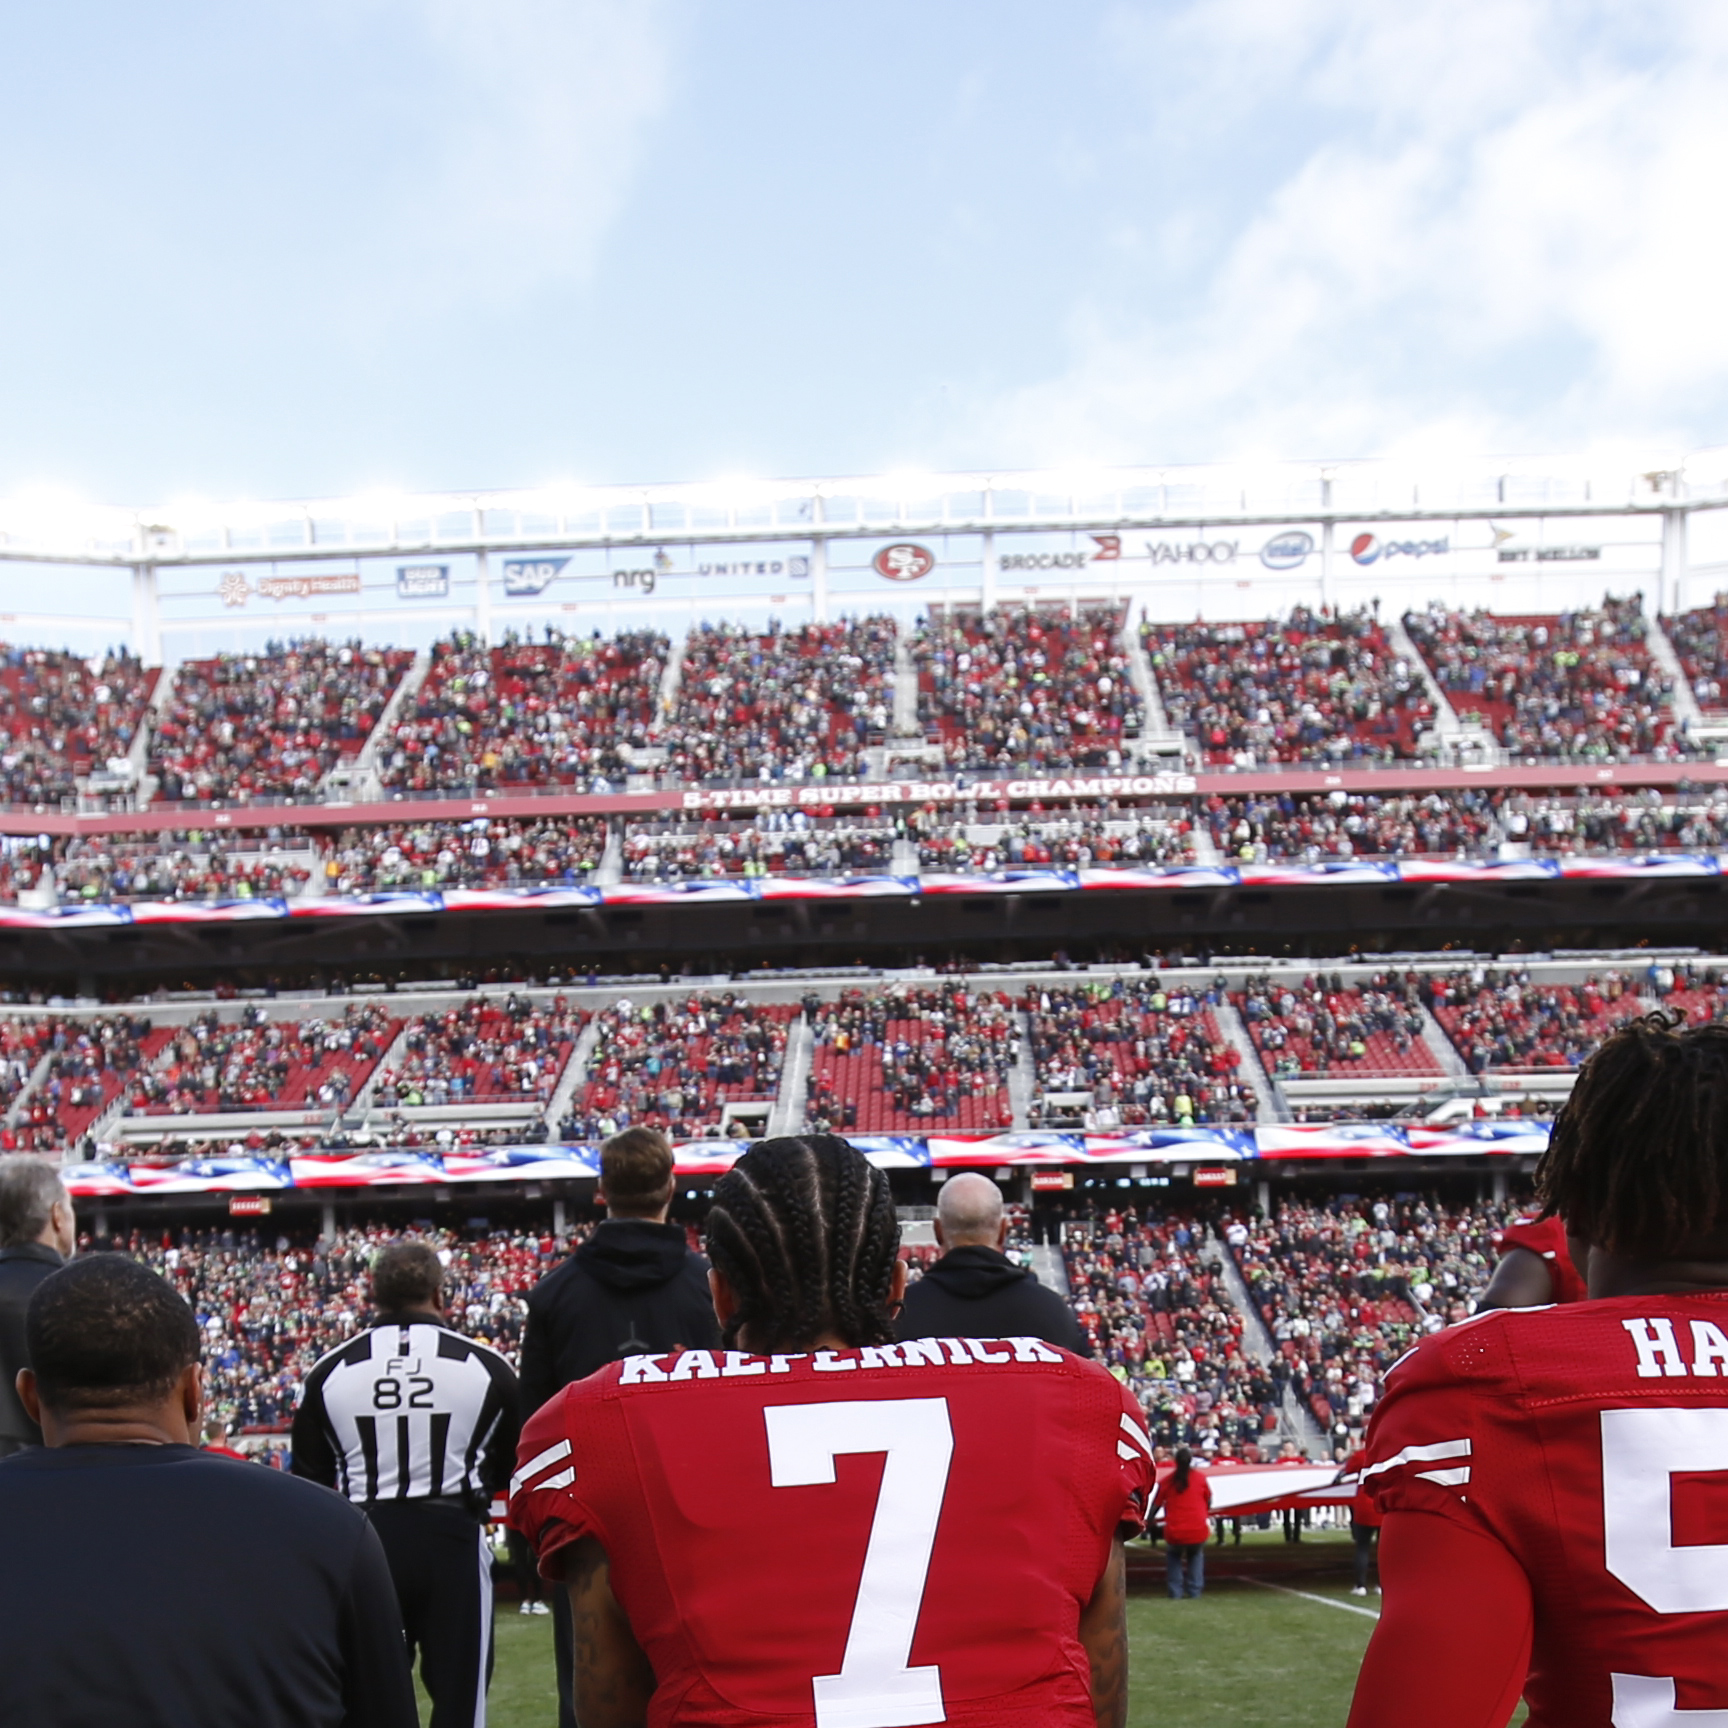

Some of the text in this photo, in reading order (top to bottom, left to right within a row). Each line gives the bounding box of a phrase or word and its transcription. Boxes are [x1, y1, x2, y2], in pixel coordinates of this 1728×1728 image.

[1146, 540, 1239, 565] YAHOO!
[1384, 535, 1449, 561] pepsi
[699, 560, 783, 576] UNITED
[1000, 552, 1087, 571] BROCADE
[505, 562, 555, 590] SAP
[614, 569, 656, 594] nrg
[683, 788, 793, 809] 5-TIME
[798, 785, 903, 805] SUPER
[1007, 776, 1197, 798] CHAMPIONS
[385, 1358, 422, 1376] FJ
[373, 1377, 434, 1410] 82
